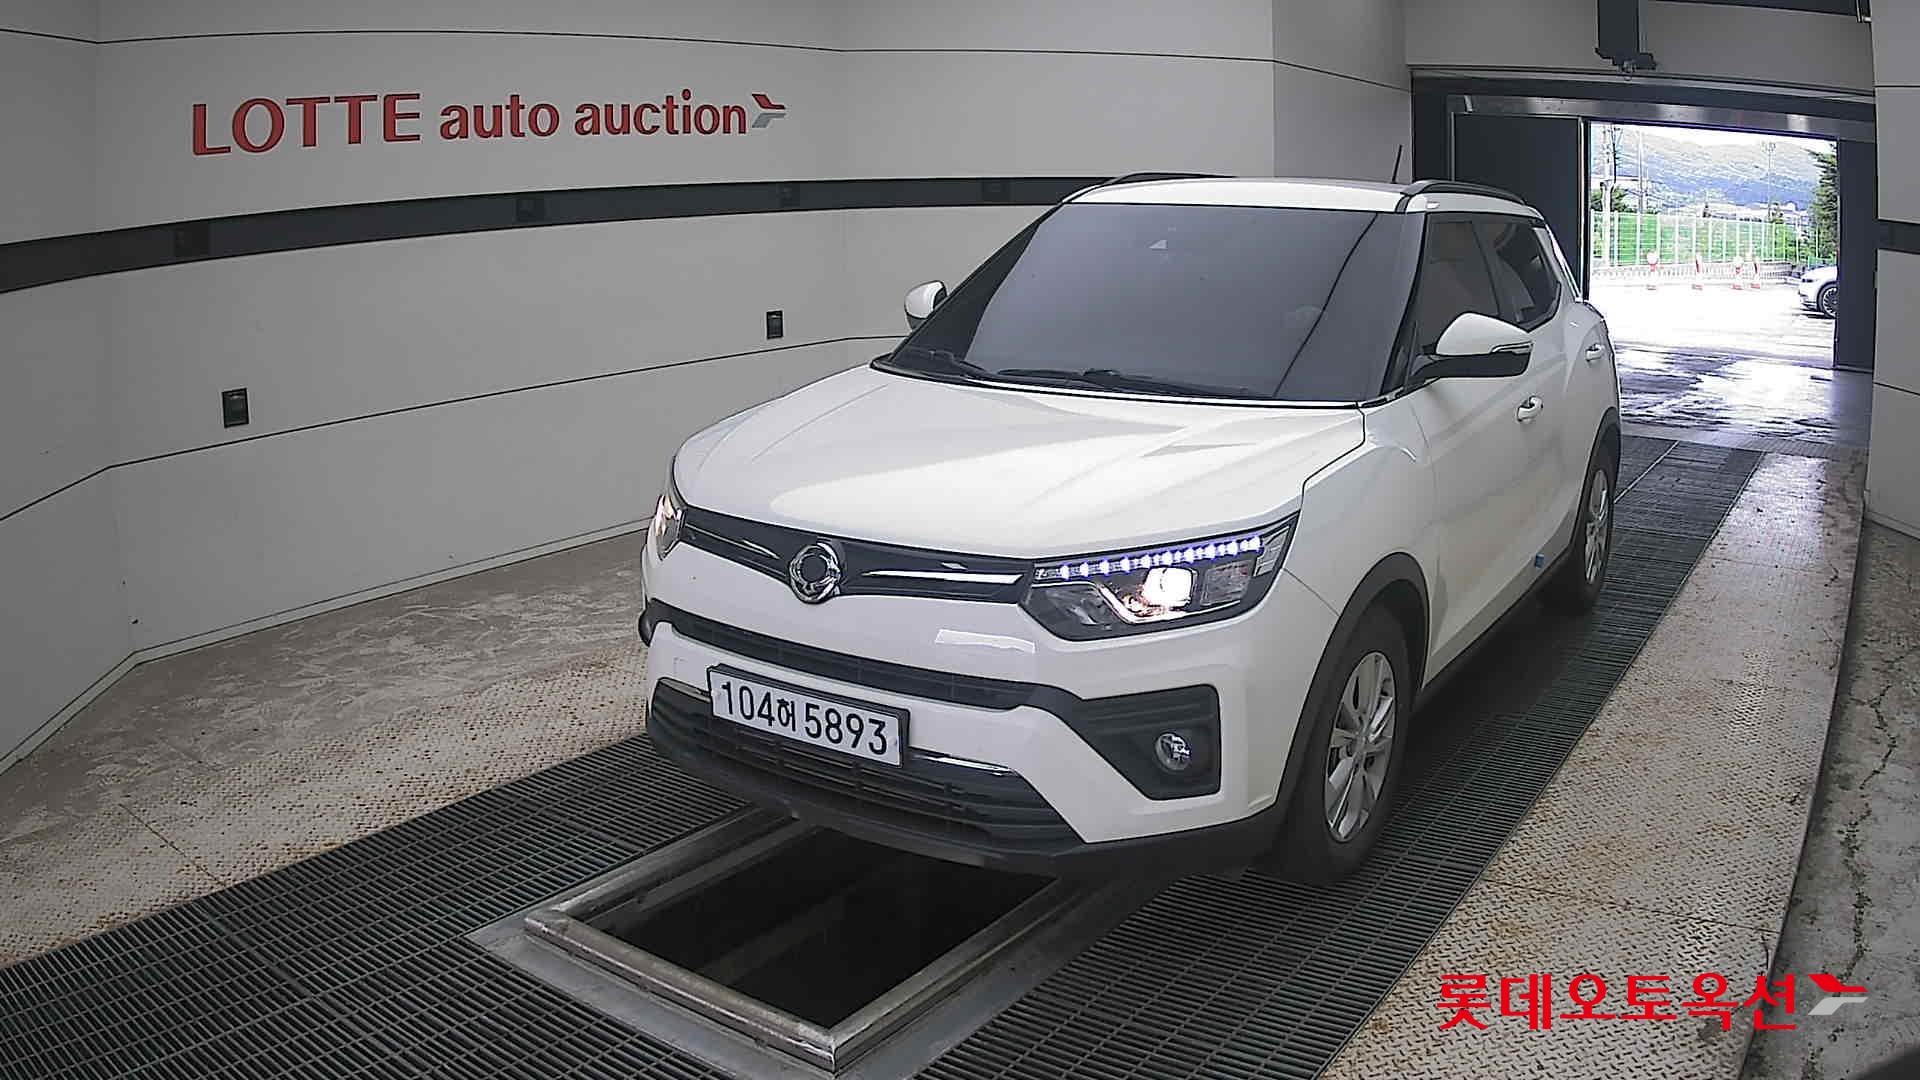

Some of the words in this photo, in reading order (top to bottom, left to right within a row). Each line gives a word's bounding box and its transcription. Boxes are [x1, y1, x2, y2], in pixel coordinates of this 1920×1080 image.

[192, 93, 421, 156] LOTTE
[439, 94, 561, 140] auto
[574, 88, 748, 135] auction
